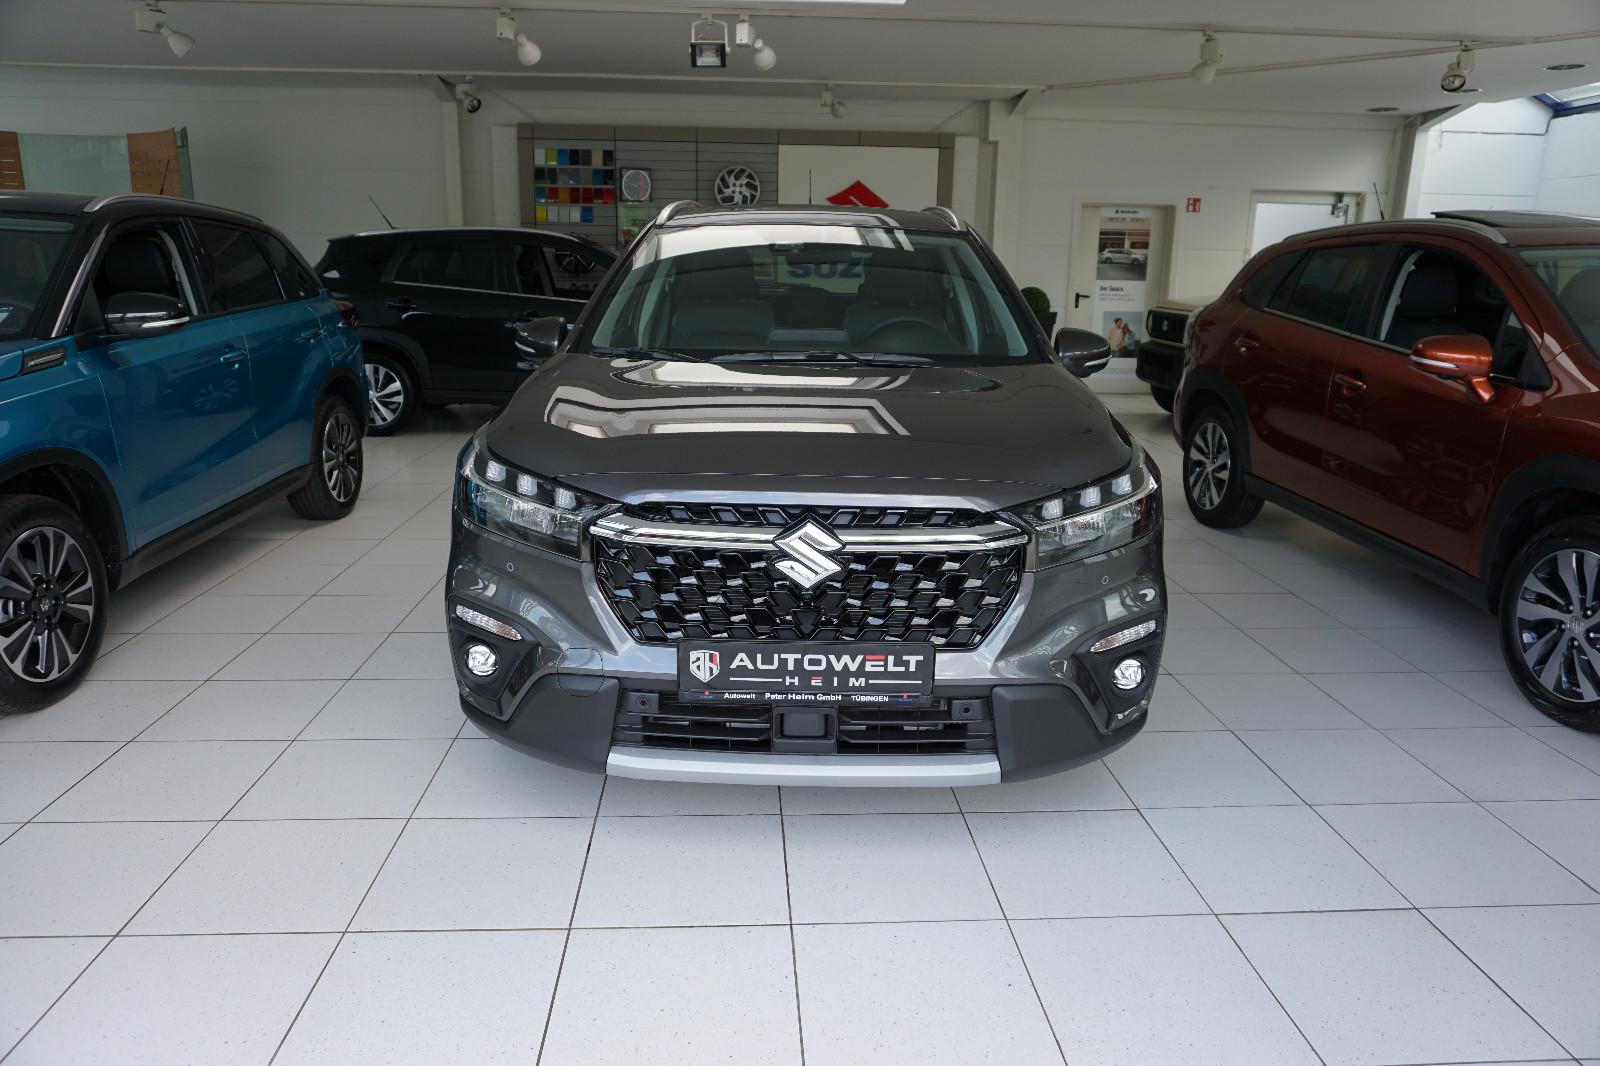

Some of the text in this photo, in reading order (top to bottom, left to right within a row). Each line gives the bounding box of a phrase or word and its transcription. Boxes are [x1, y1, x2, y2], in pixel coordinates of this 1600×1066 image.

[729, 652, 924, 672] AUTOWELT
[785, 676, 866, 687] HEIM
[765, 692, 786, 700] Peter
[851, 694, 889, 702] TÜBINGEN
